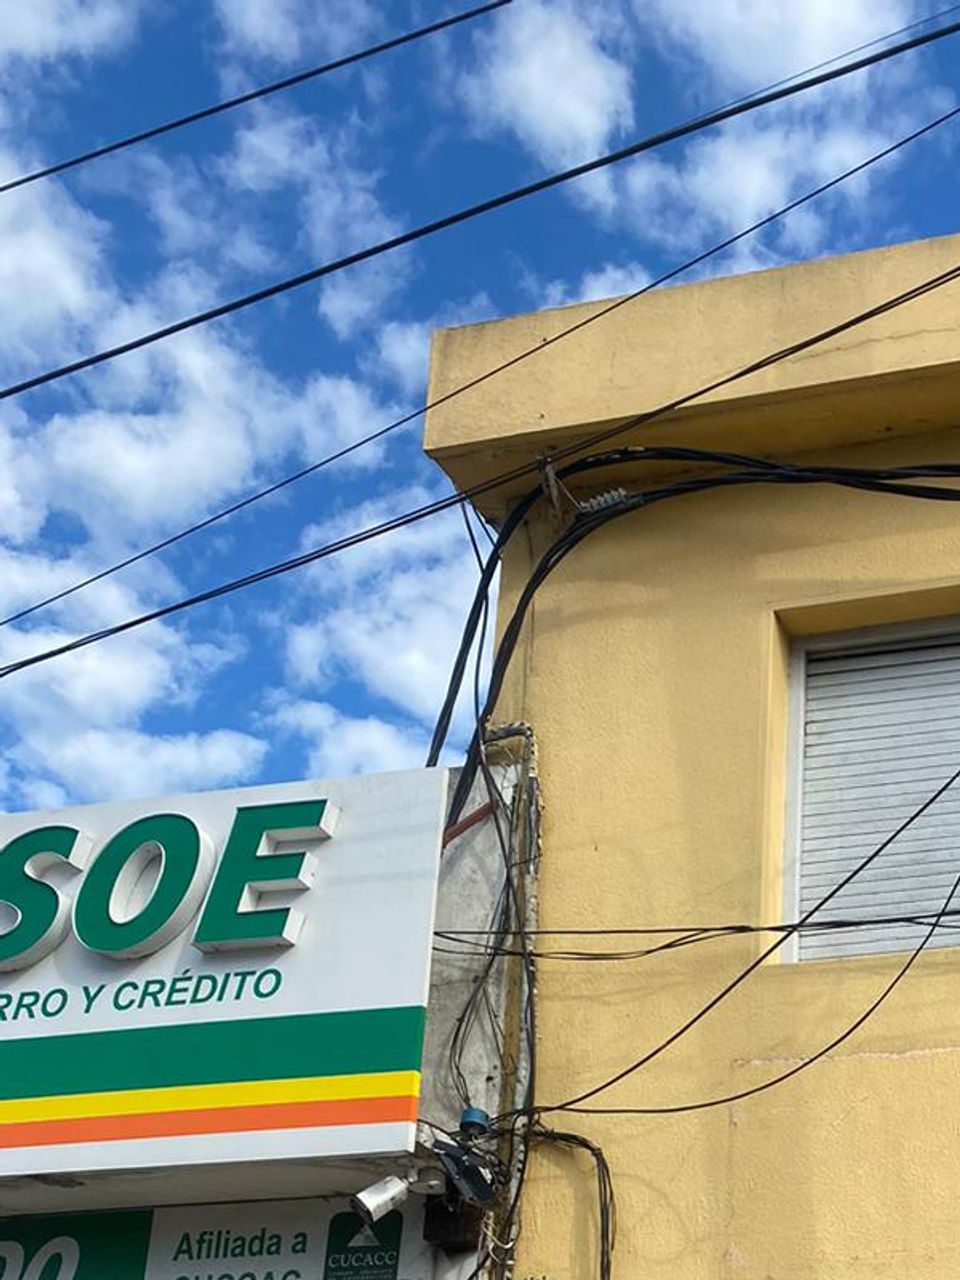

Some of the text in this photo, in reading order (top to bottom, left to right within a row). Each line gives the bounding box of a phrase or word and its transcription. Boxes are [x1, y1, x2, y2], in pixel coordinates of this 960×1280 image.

[82, 984, 105, 1014] Y
[113, 968, 282, 1011] CRÉDITO
[172, 1228, 308, 1262] Afiliada a
